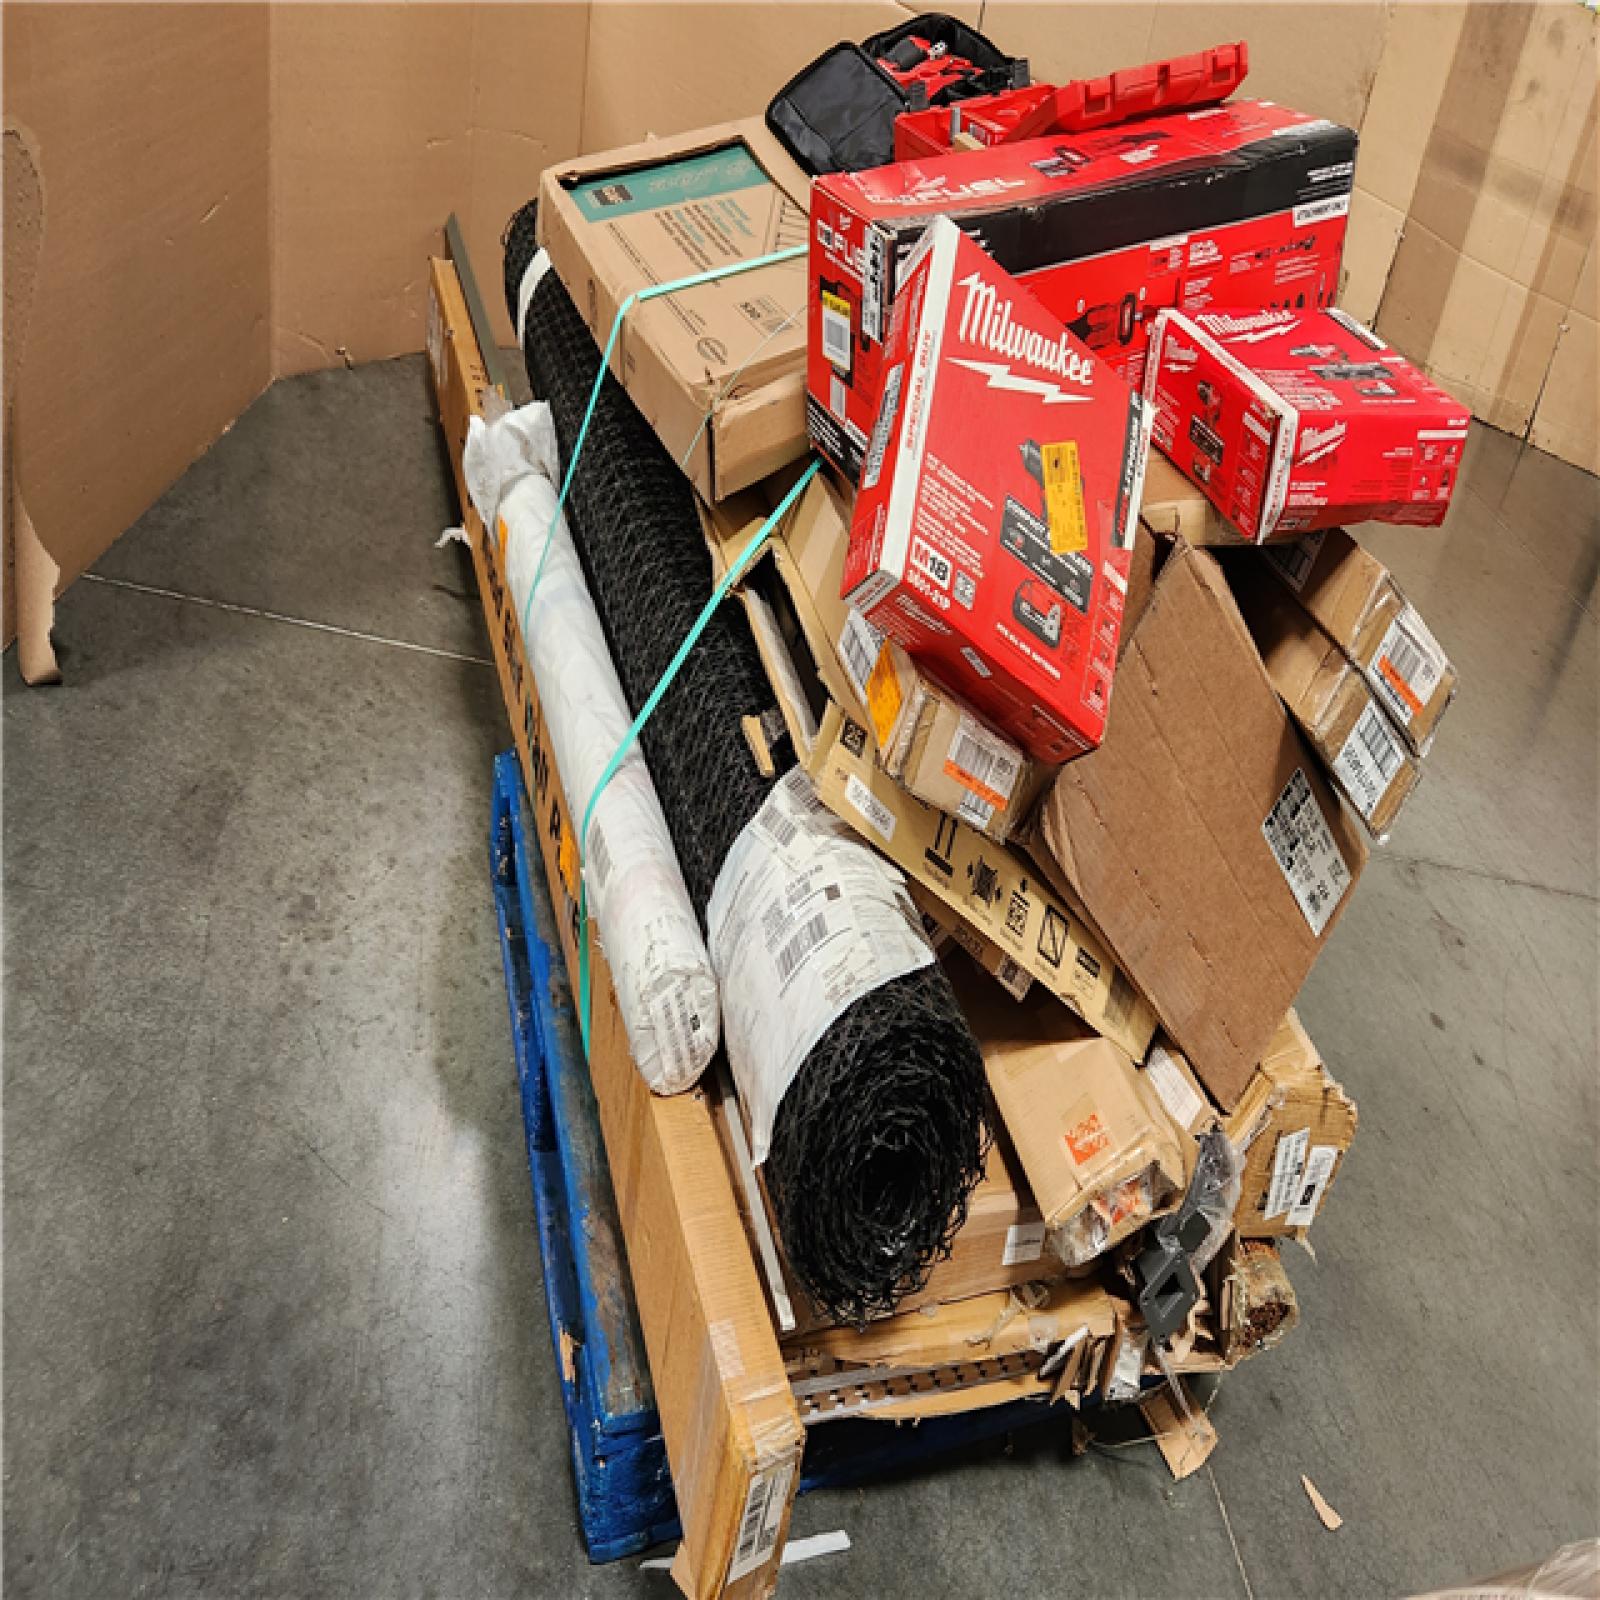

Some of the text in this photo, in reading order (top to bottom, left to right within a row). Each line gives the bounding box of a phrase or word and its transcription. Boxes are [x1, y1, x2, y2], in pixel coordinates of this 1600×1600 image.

[957, 271, 1093, 385] Milwaukee
[1196, 309, 1295, 335] Milwaukee
[913, 540, 950, 582] M18
